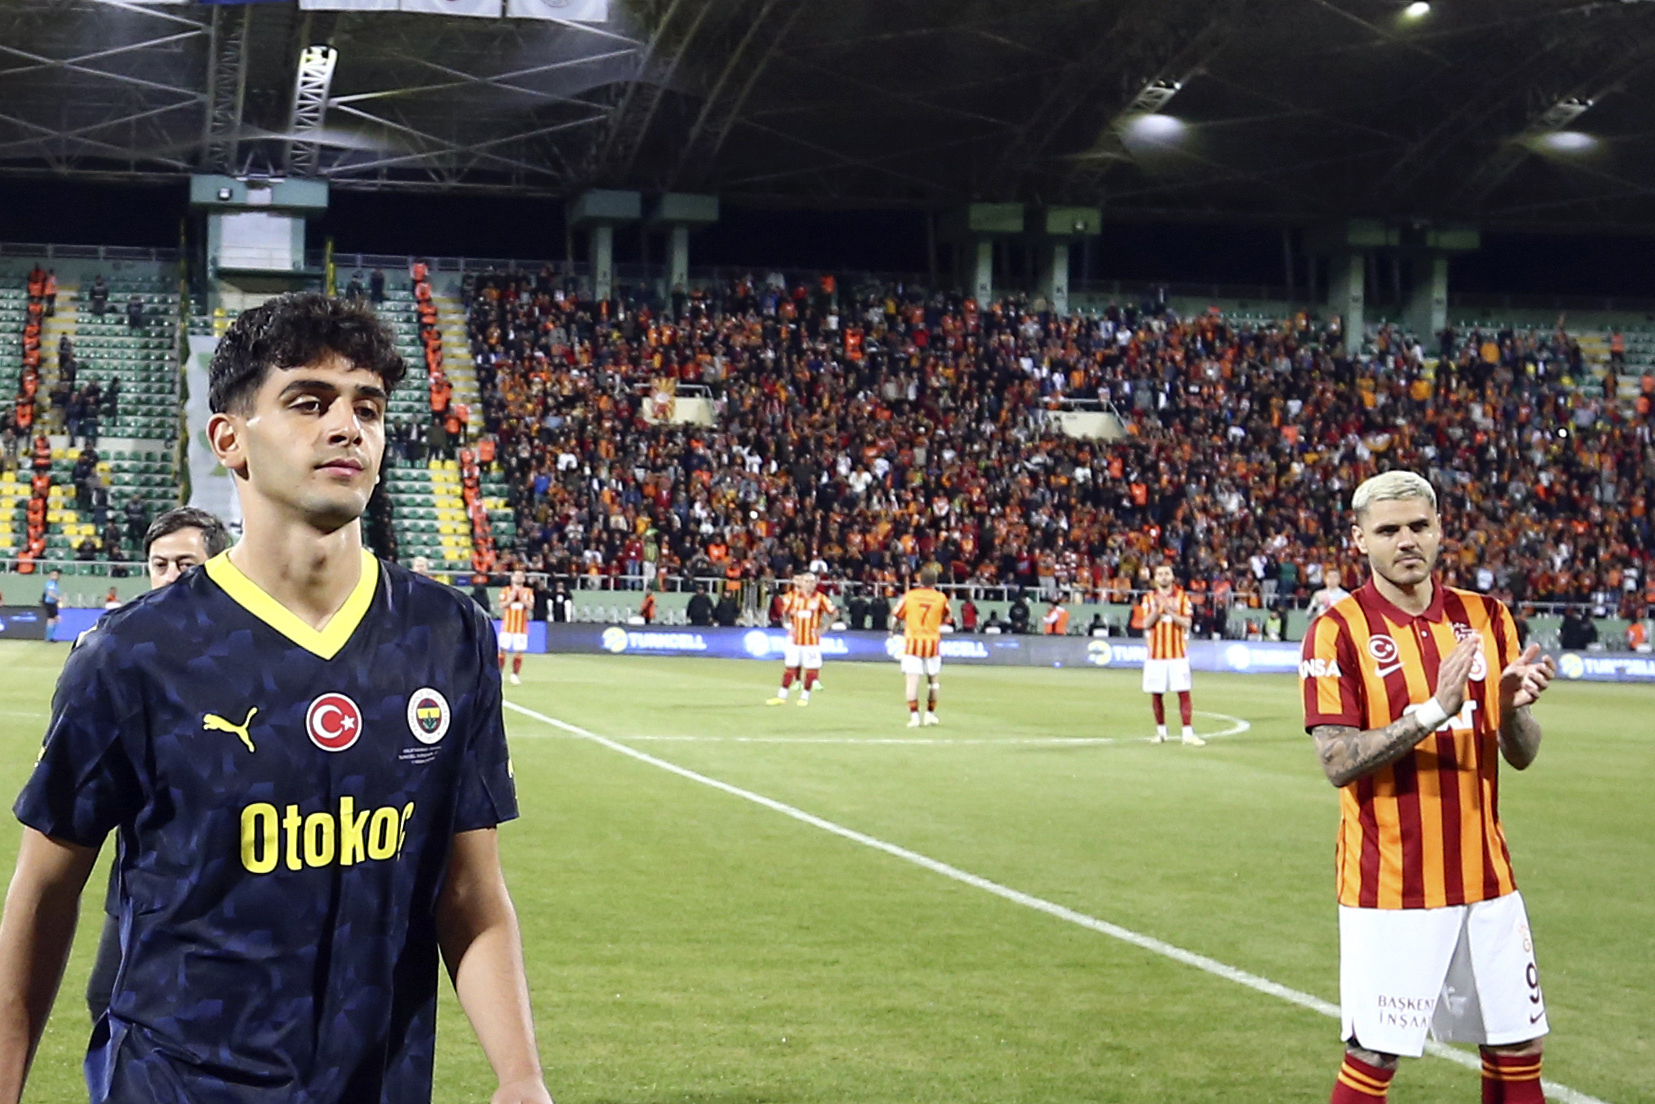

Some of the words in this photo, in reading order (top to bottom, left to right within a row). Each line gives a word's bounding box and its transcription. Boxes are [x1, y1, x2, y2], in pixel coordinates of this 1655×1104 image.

[918, 603, 932, 627] 7
[627, 631, 708, 651] TURKCELL
[1525, 961, 1541, 1005] 9
